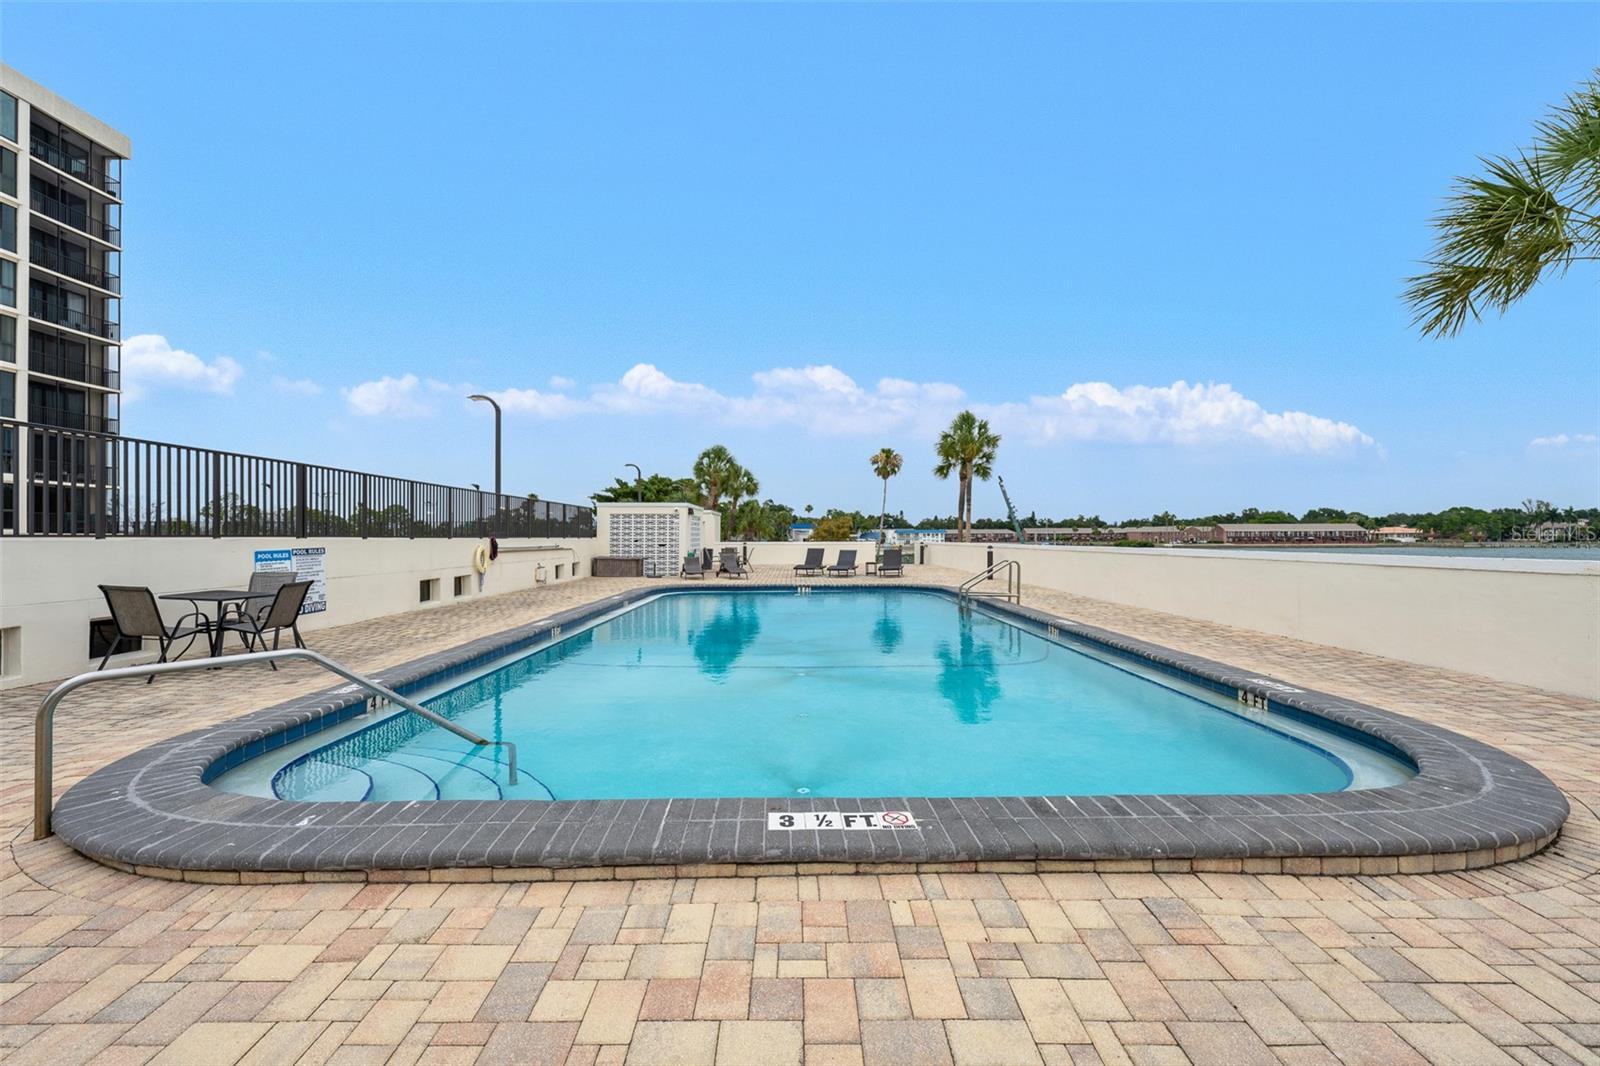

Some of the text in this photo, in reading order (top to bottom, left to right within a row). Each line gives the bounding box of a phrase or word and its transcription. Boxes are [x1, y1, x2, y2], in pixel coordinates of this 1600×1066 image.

[304, 601, 326, 613] DIVING
[1241, 690, 1266, 710] 4 FT
[779, 814, 795, 828] 3
[843, 814, 878, 828] FT.
